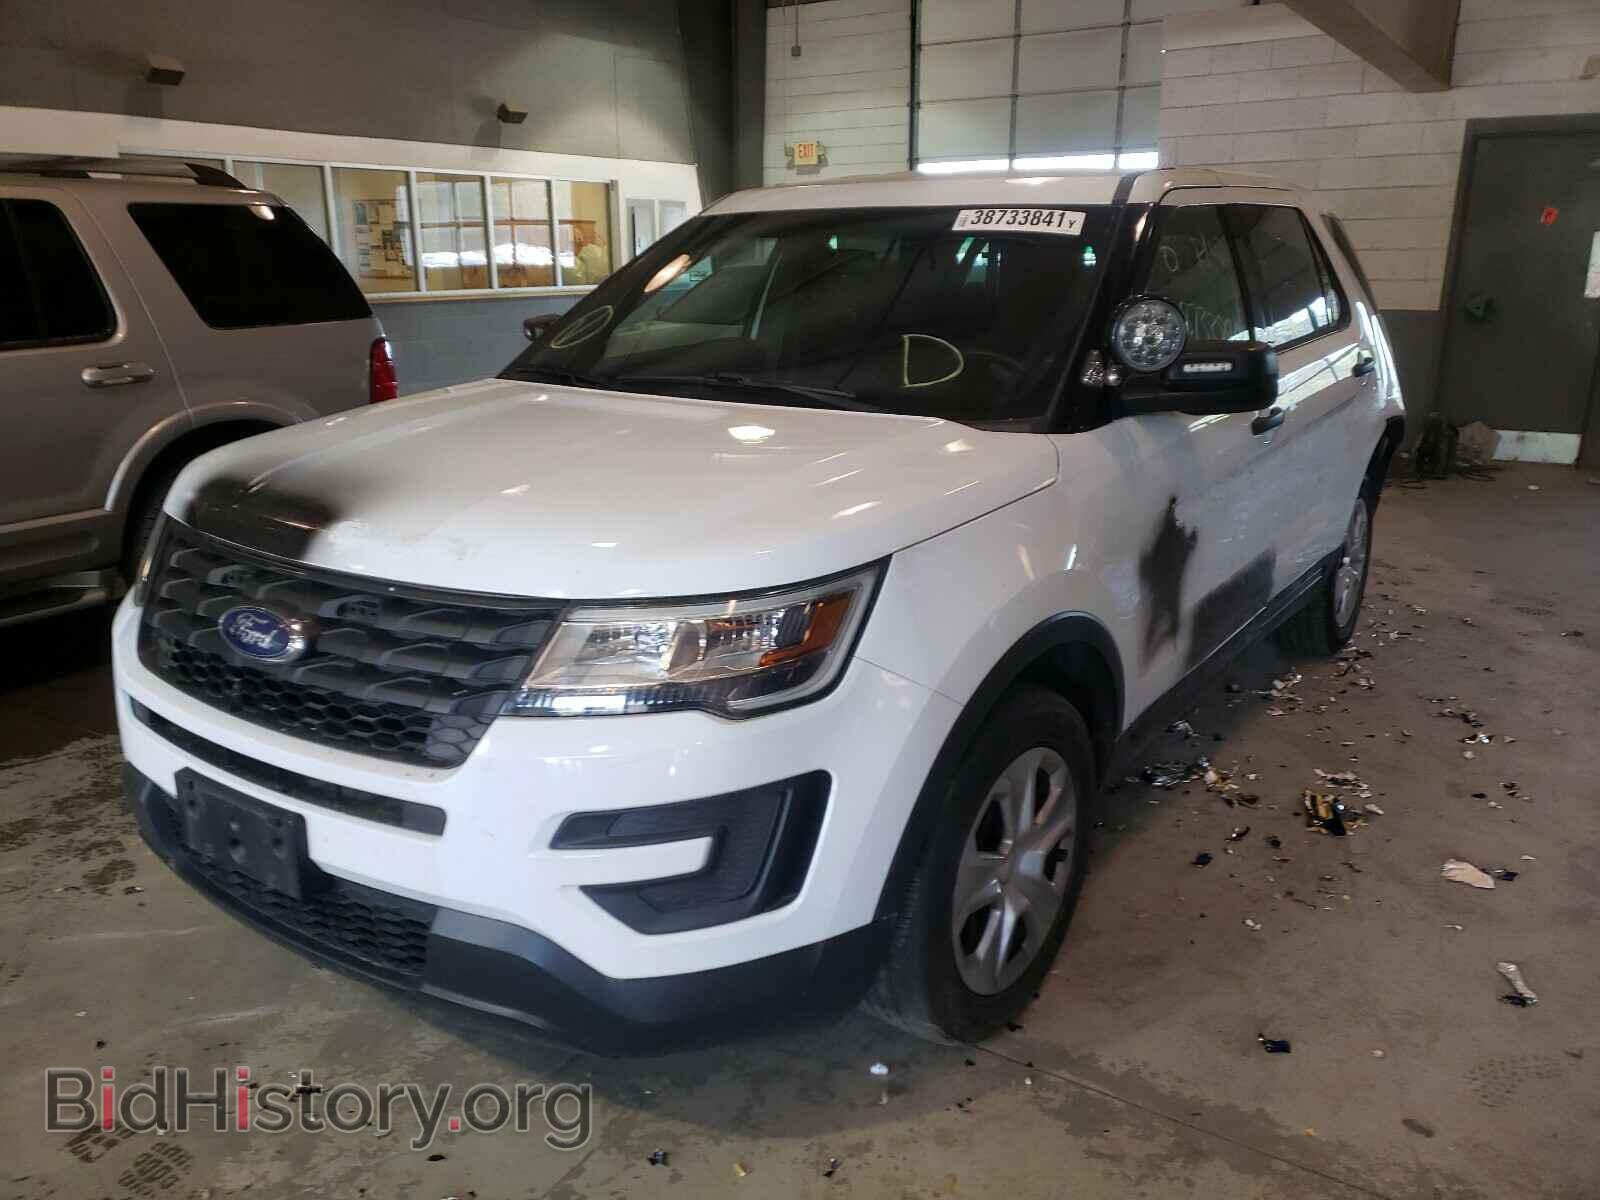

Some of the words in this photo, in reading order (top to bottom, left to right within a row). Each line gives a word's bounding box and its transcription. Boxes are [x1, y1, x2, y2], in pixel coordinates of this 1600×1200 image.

[798, 143, 815, 159] EXIT
[970, 209, 1067, 228] 38733841
[1068, 219, 1077, 229] Y
[229, 613, 278, 649] Ford
